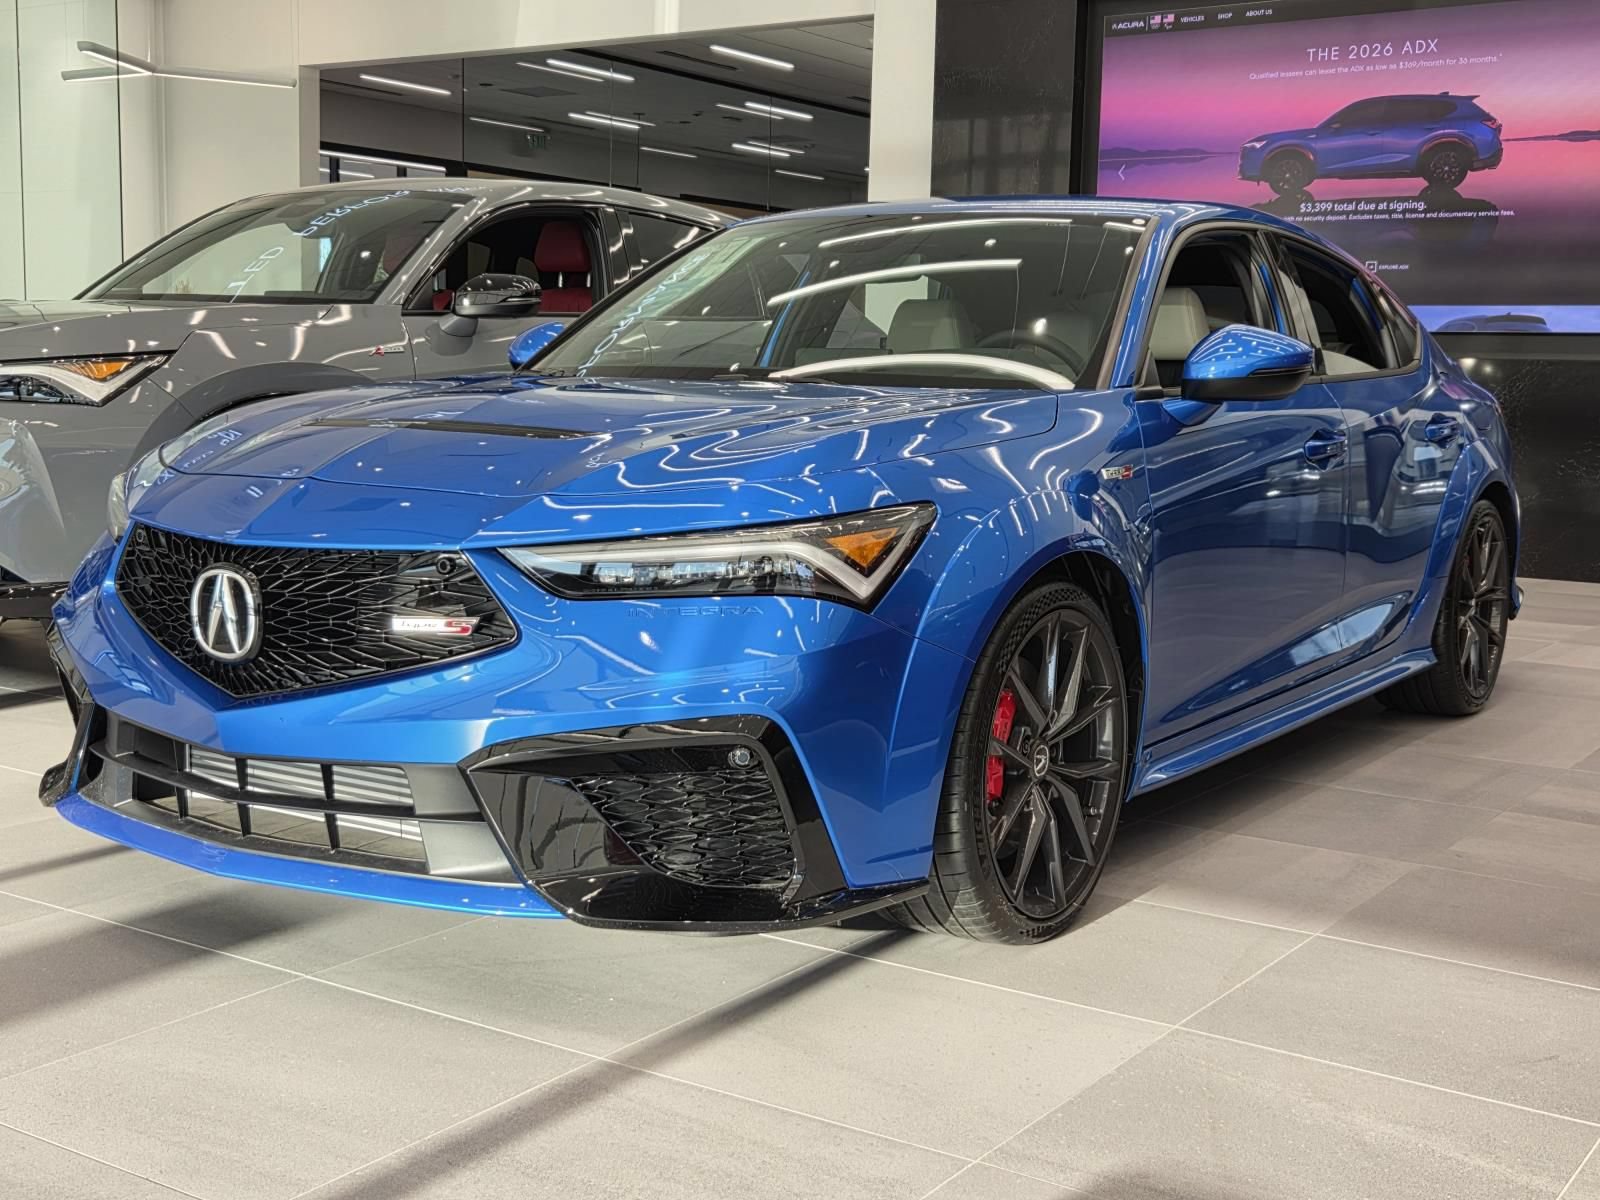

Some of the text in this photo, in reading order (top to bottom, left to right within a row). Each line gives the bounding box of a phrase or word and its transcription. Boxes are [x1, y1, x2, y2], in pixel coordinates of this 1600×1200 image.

[1180, 15, 1205, 24] VEHICLES
[1217, 12, 1233, 20] SHOP
[1117, 20, 1145, 29] ACURA
[1306, 38, 1439, 62] THE 2026 ADX
[1249, 70, 1279, 80] Qualified
[1318, 67, 1337, 75] lease
[1399, 59, 1445, 69] $369/month
[1458, 57, 1468, 65] 36
[1300, 199, 1427, 213] $3,399 total due at signing.
[1304, 214, 1324, 222] security
[1325, 214, 1346, 222] deposit.
[1405, 211, 1425, 219] license
[1438, 210, 1477, 219] documentary
[1478, 209, 1499, 217] service
[628, 606, 765, 619] INTEGRA
